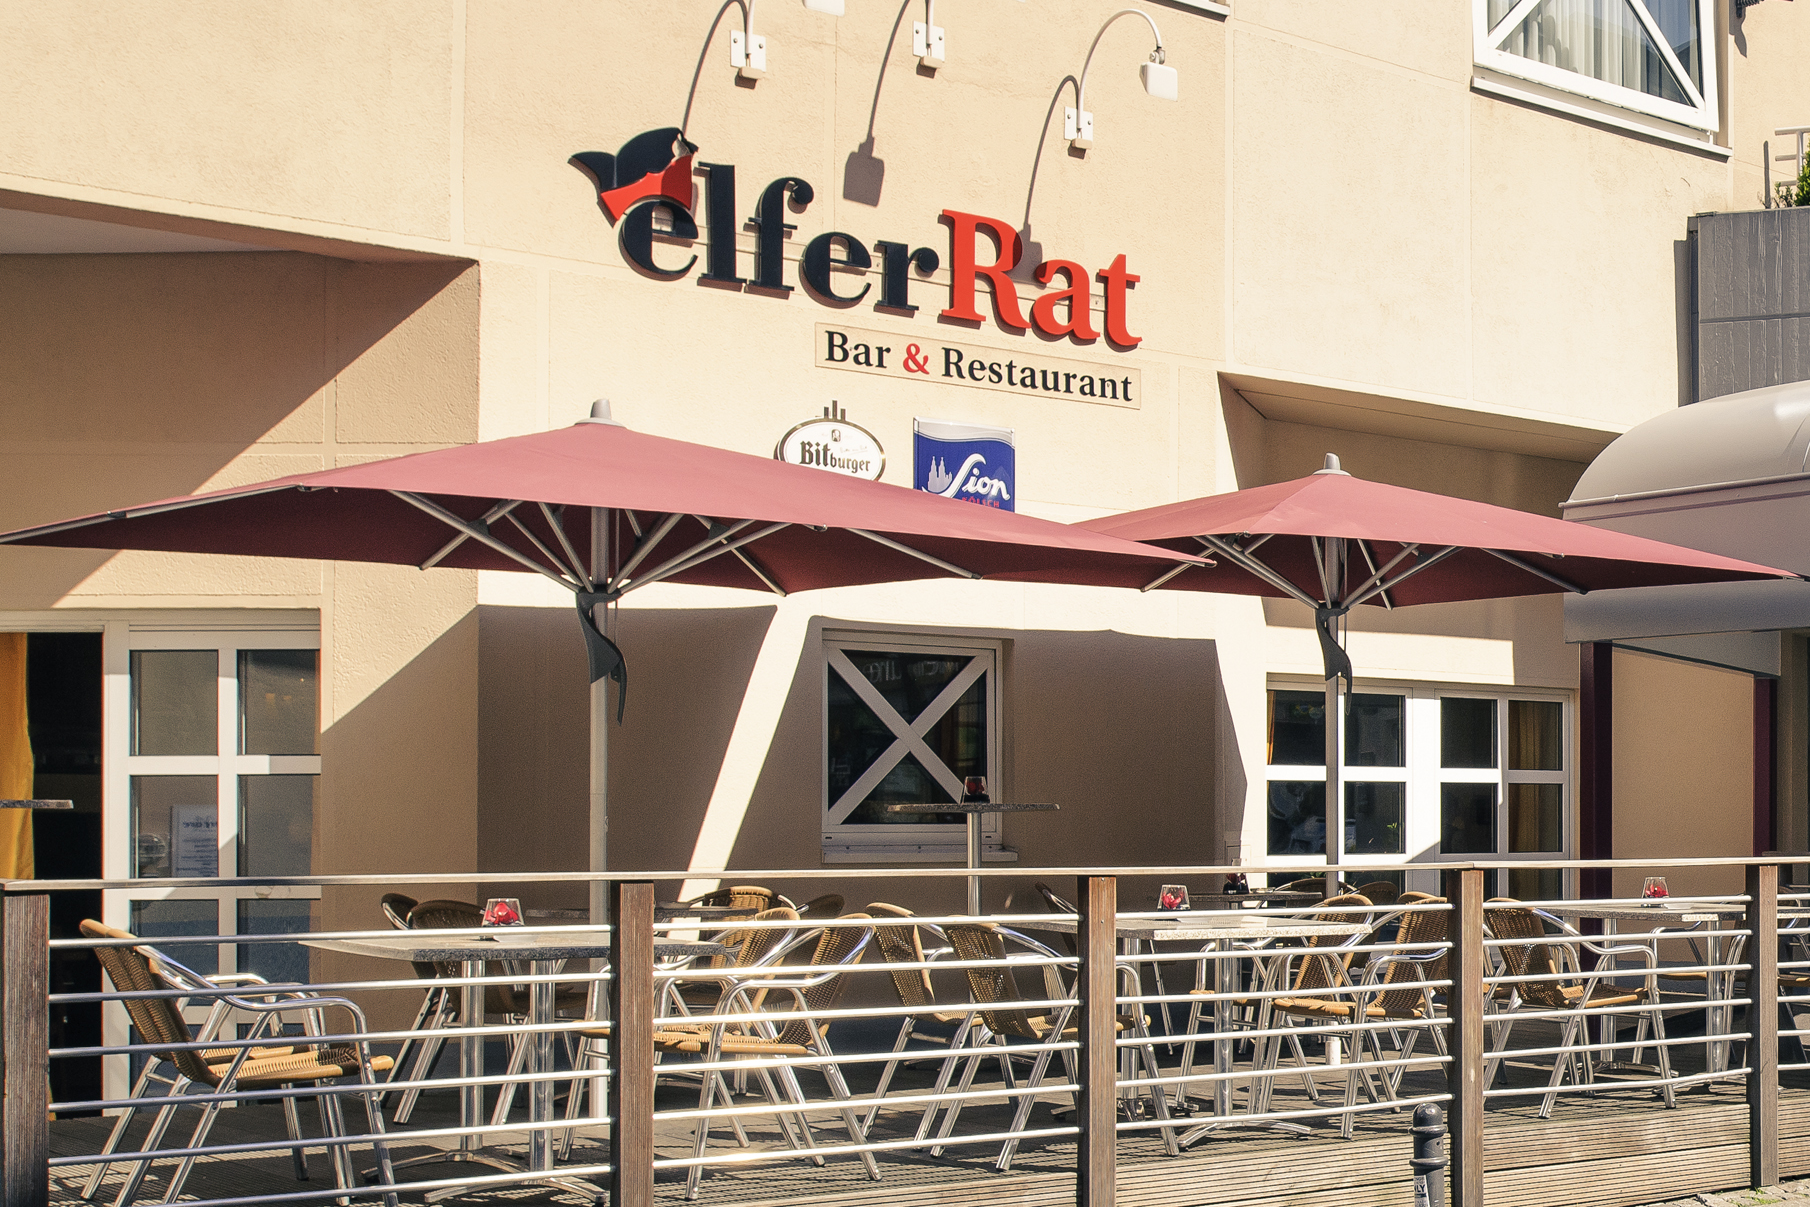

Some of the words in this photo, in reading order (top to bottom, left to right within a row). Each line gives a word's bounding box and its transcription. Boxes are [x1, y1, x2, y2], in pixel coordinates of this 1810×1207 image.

[824, 330, 891, 369] Bar
[902, 343, 930, 375] &
[941, 347, 1133, 402] Restaurant
[799, 440, 871, 474] Bitburger
